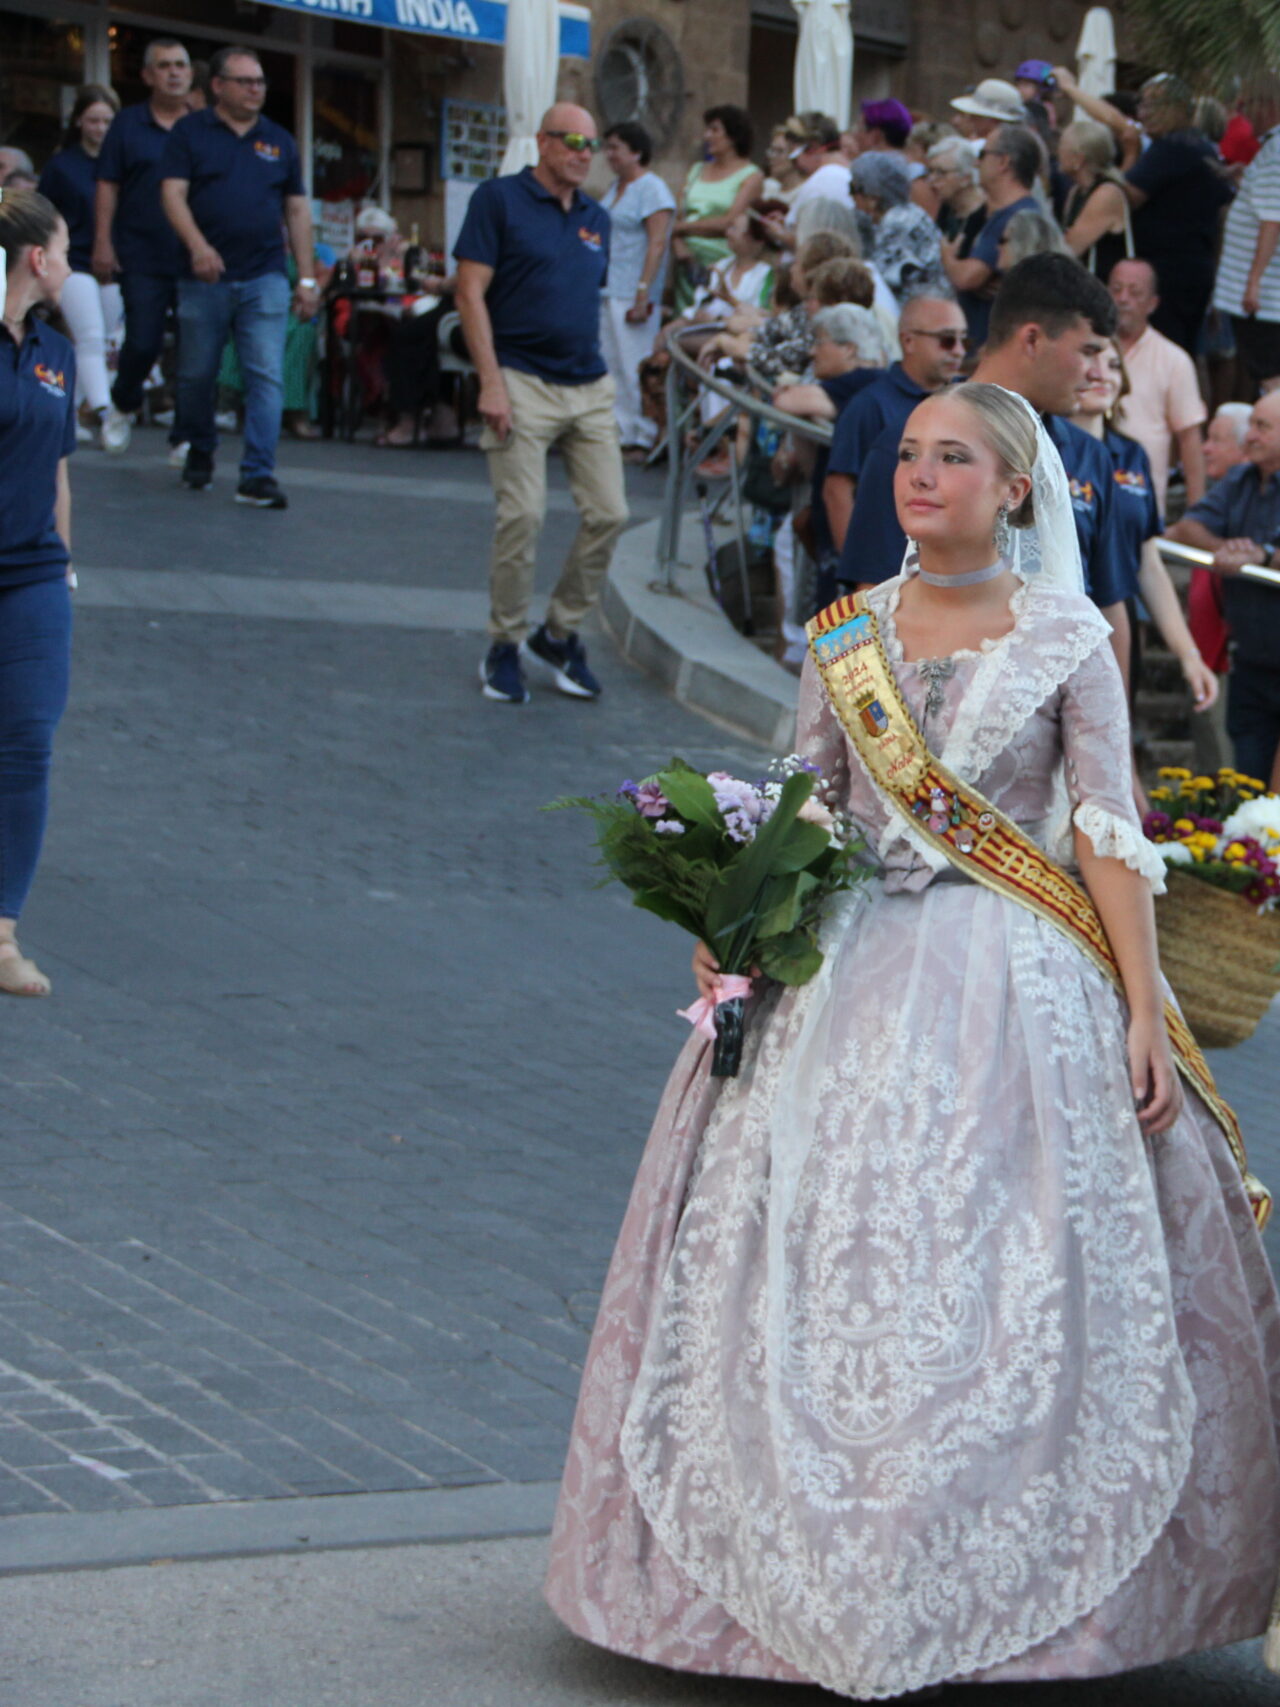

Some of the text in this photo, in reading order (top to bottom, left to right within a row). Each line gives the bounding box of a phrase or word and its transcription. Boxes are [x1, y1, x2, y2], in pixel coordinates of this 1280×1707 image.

[396, 0, 480, 35] INDIA
[842, 661, 868, 685] 2024
[999, 846, 1072, 905] Dama
